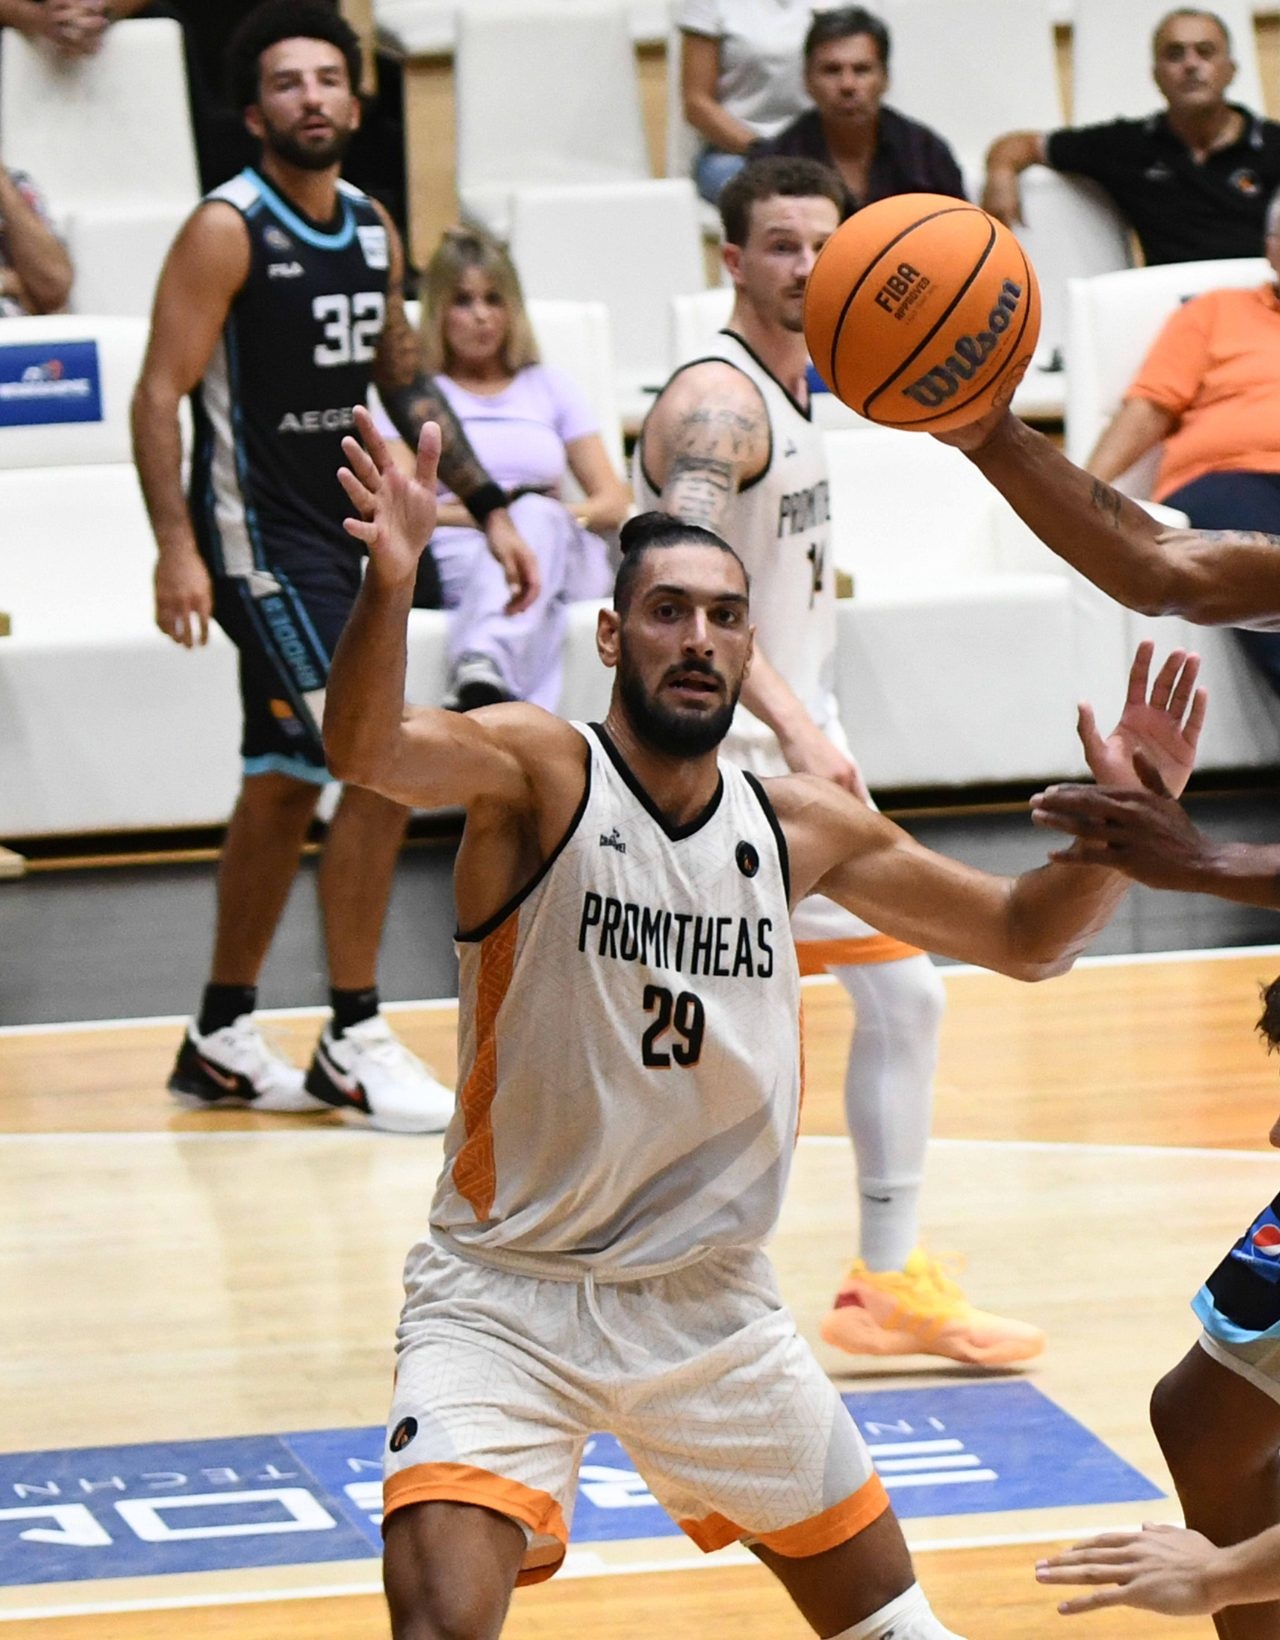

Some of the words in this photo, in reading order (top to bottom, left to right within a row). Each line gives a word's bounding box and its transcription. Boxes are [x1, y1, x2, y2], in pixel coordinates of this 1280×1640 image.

[874, 262, 920, 313] FIBA
[894, 276, 930, 321] APPROVED
[312, 291, 386, 367] 32
[902, 278, 1022, 407] Wilson
[277, 407, 356, 434] AEGE
[578, 891, 774, 978] PROMITHEAS
[641, 984, 706, 1069] 29
